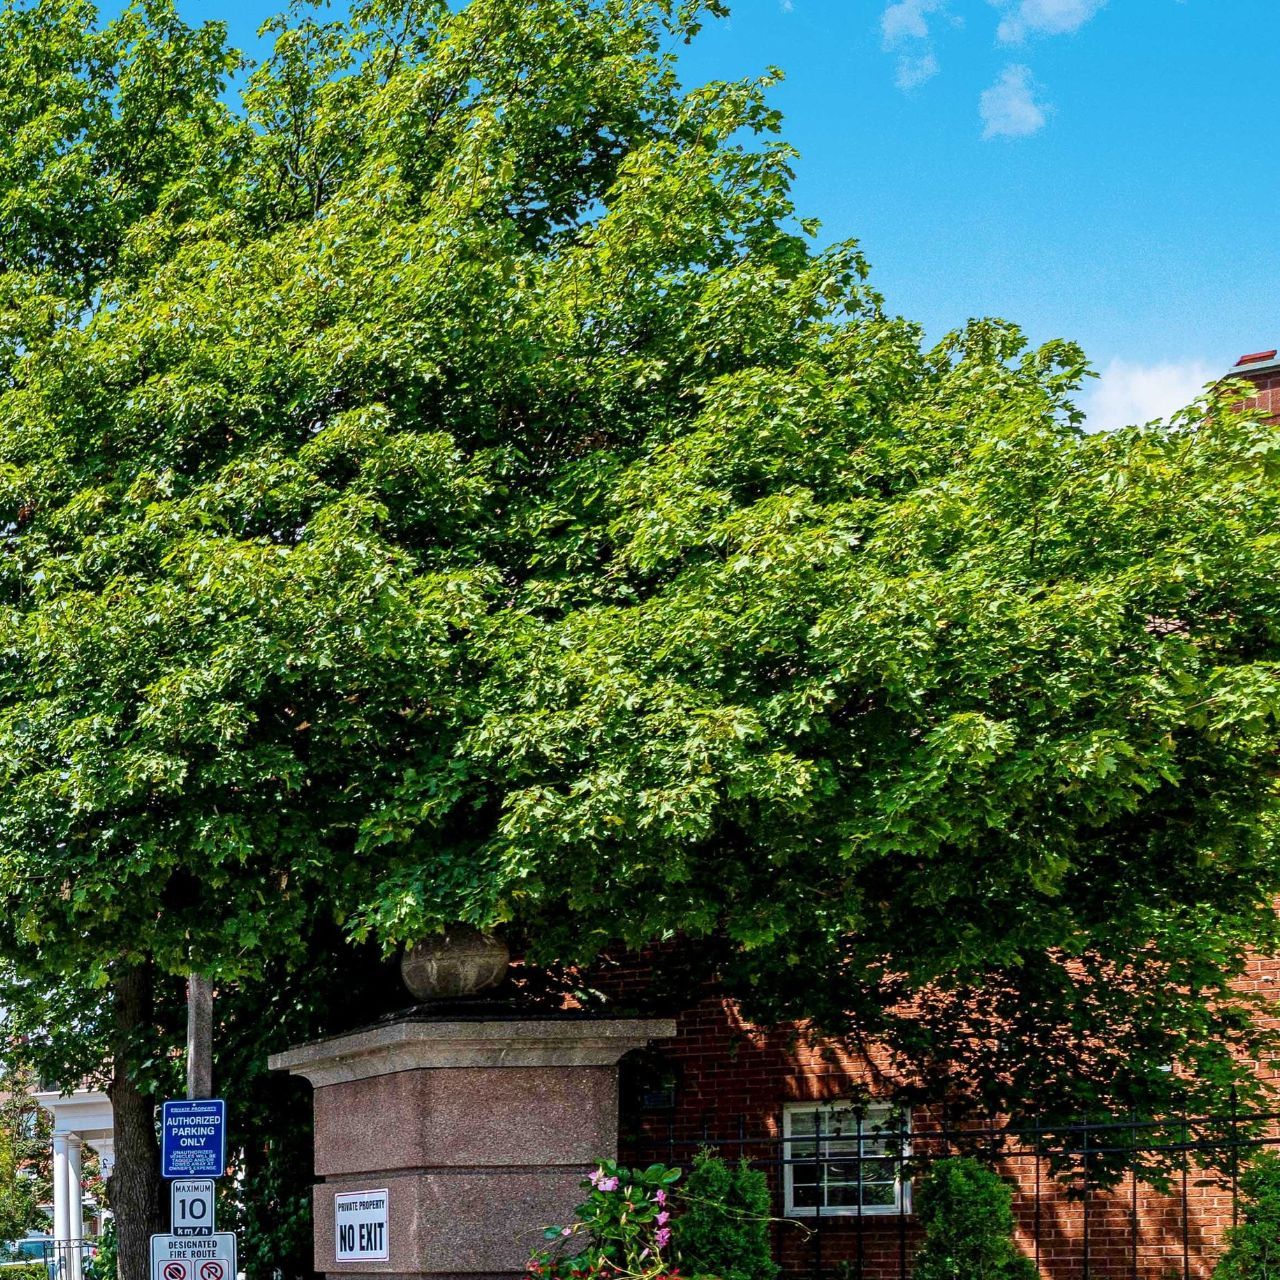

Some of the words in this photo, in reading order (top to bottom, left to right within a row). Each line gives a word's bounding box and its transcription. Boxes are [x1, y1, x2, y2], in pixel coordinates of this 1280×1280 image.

[166, 1115, 221, 1126] AUTHORIZED
[172, 1126, 215, 1136] PARKING
[180, 1137, 206, 1147] ONLY
[175, 1184, 211, 1193] MAXIMUM
[179, 1198, 207, 1220] 10
[338, 1201, 358, 1212] PRIVATE
[359, 1199, 385, 1211] PROPERTY
[177, 1227, 208, 1235] km/h
[339, 1224, 355, 1252] NO
[359, 1222, 384, 1251] EXIT
[168, 1240, 218, 1249] DESIGNATED
[170, 1250, 187, 1258] FIRE
[191, 1249, 217, 1258] ROUTE
